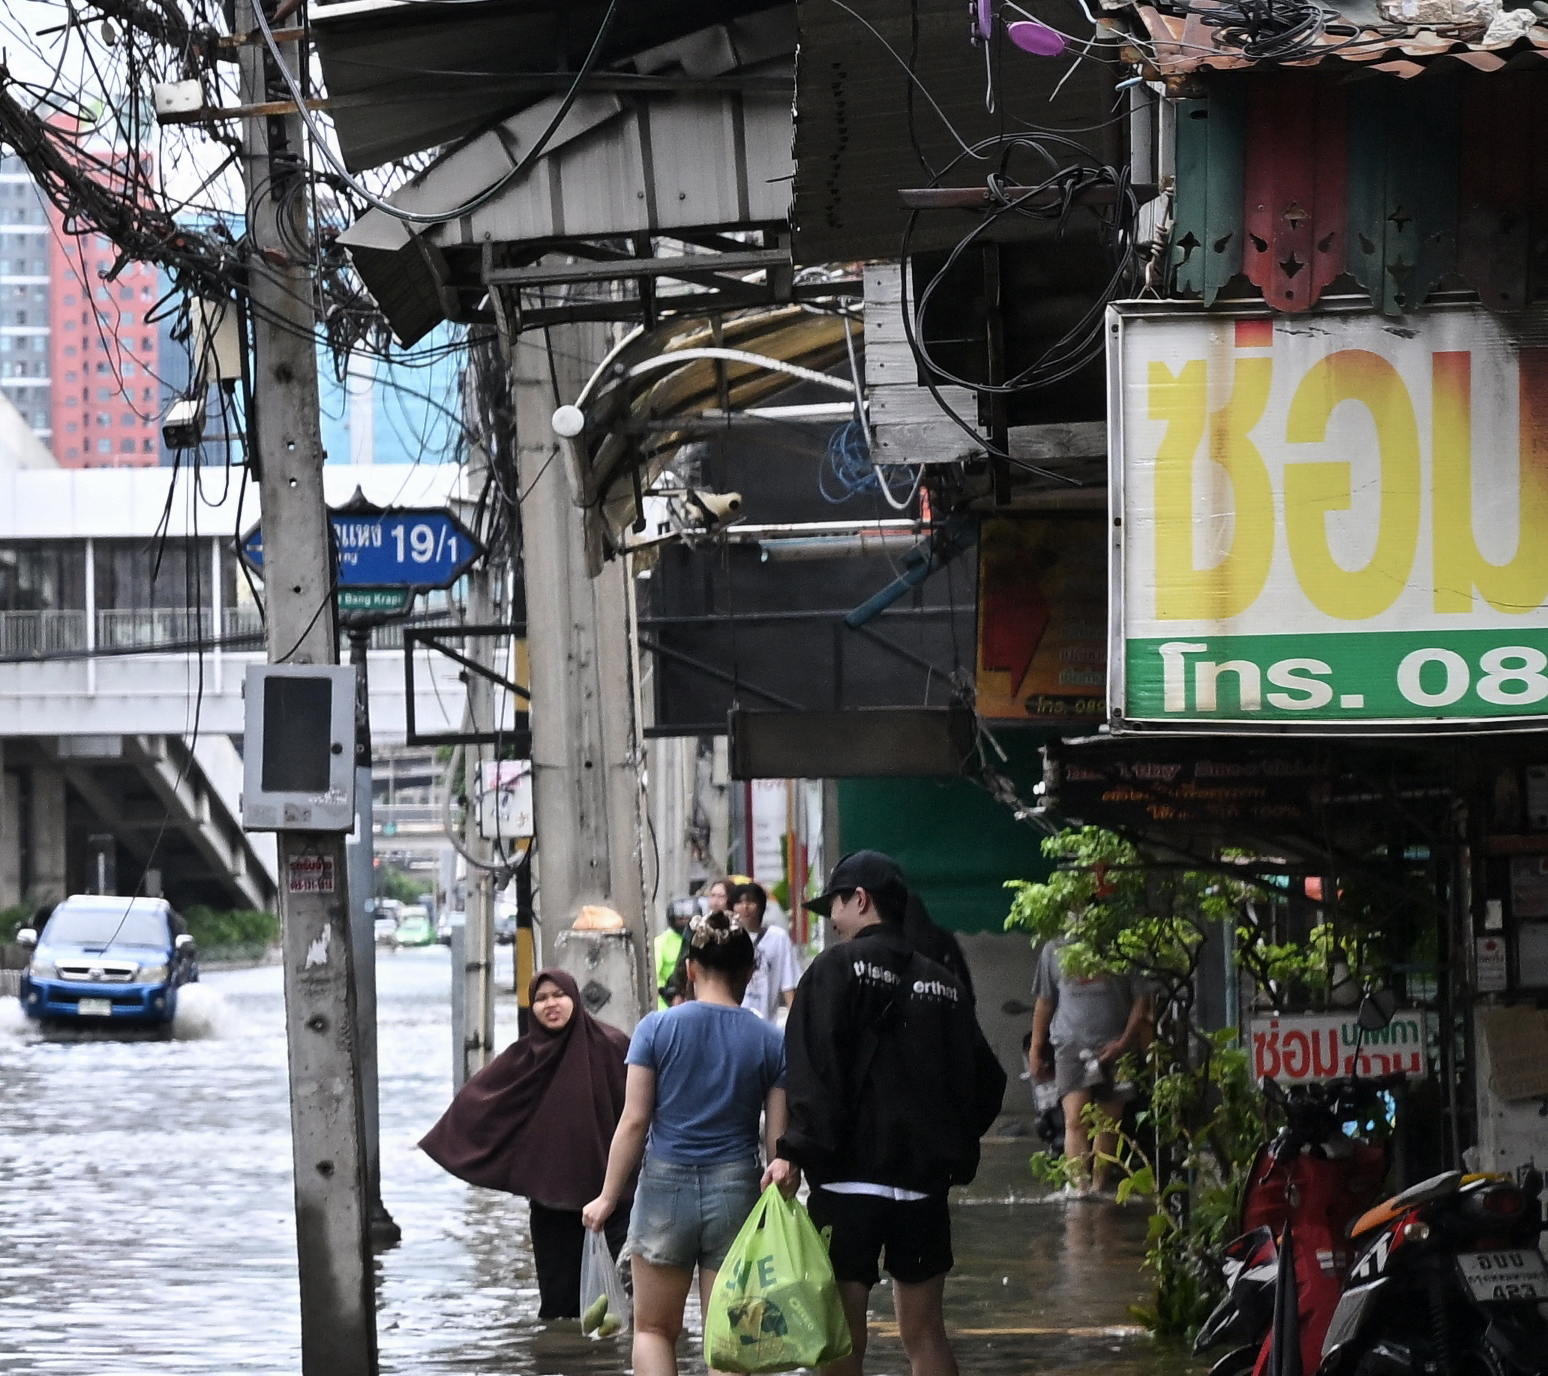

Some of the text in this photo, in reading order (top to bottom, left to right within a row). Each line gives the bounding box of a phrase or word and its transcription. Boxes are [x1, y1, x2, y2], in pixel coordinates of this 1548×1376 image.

[391, 523, 458, 563] 19/1
[344, 591, 402, 608] Bang Krapi
[1159, 641, 1548, 714] โทร. 08
[1253, 1020, 1340, 1078] ซ่อม
